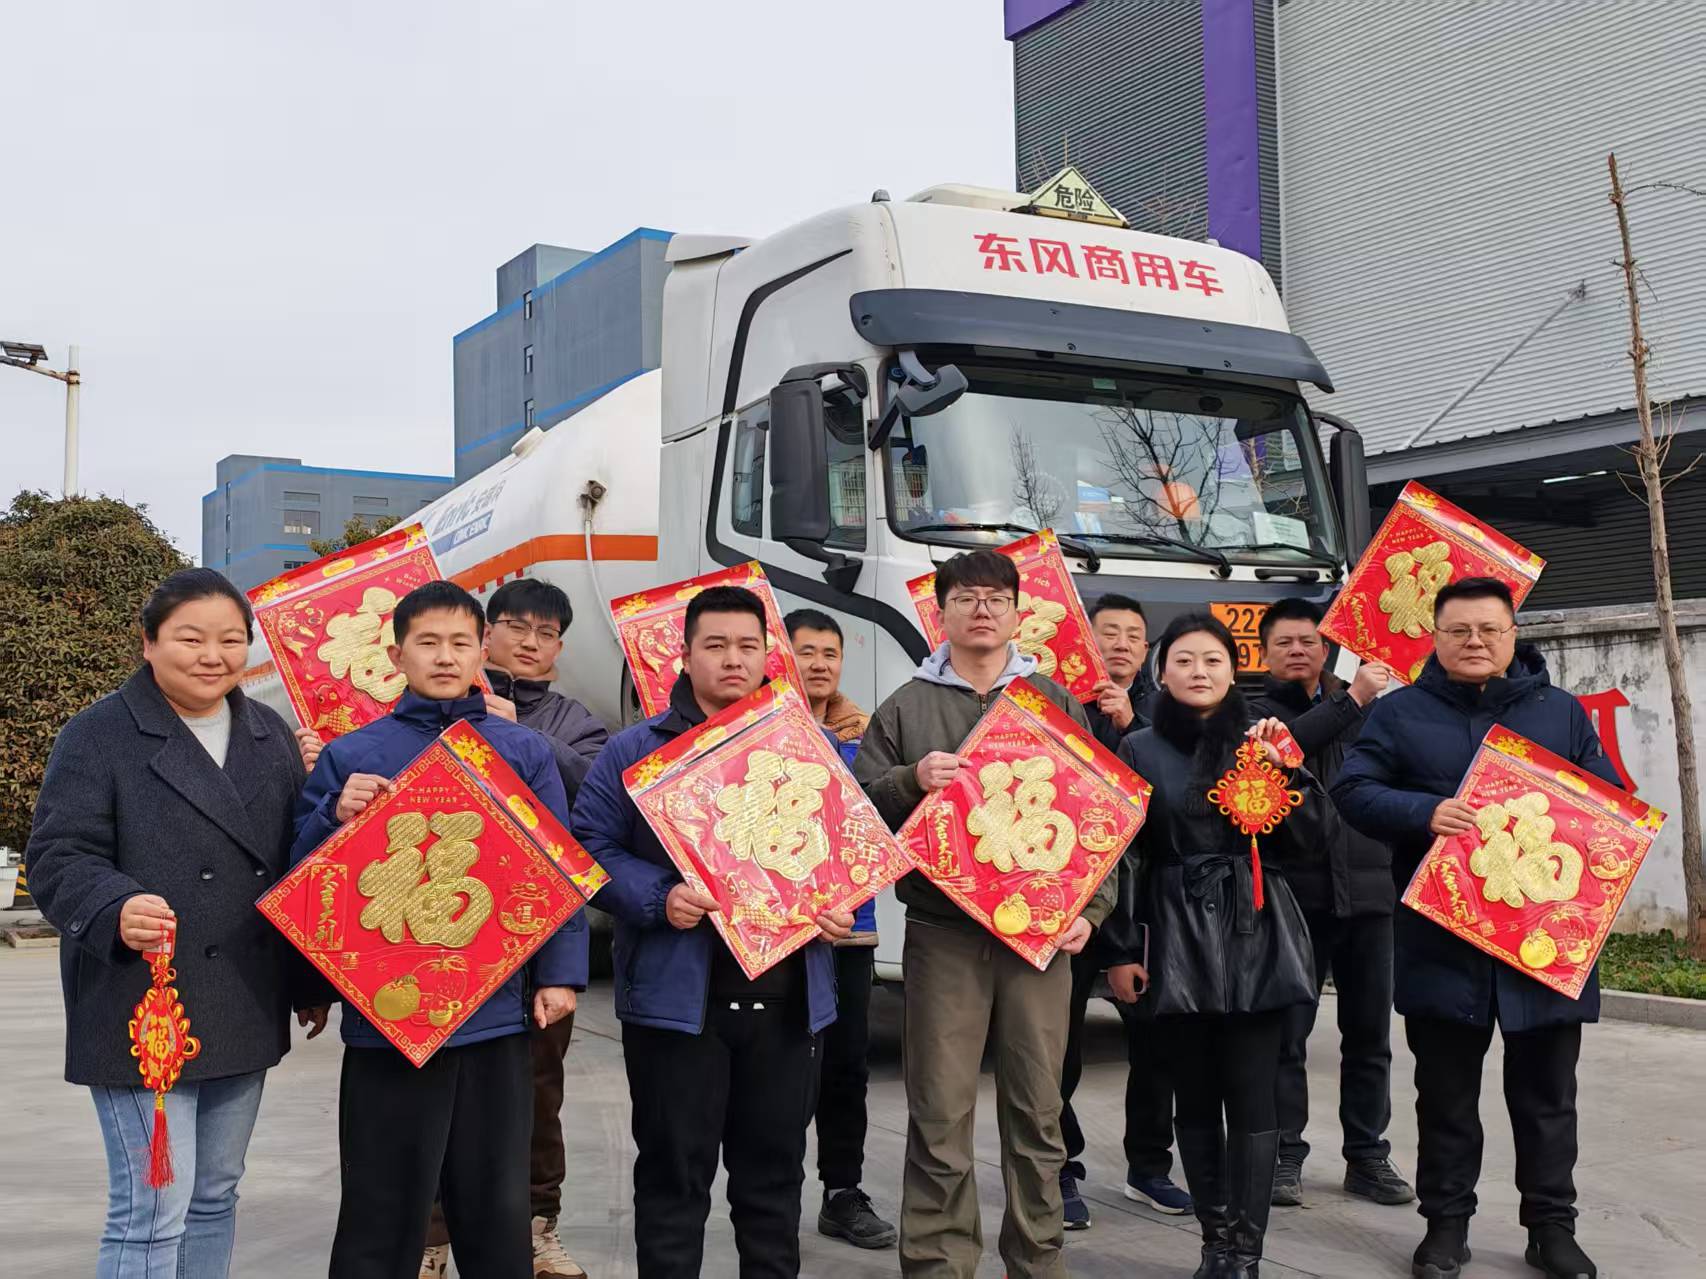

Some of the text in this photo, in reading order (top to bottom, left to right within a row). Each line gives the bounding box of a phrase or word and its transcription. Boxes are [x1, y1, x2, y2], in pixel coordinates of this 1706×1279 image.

[1054, 184, 1095, 211] 危险
[974, 233, 1224, 296] 东风商用车
[1033, 576, 1051, 588] rich
[1237, 643, 1265, 669] 97
[409, 796, 457, 804] NEW YEAR
[419, 786, 450, 794] HAPPY
[1234, 779, 1272, 815] 福
[714, 749, 831, 881] 福
[966, 755, 1077, 873] 福
[1470, 791, 1584, 909] 福
[358, 810, 495, 949] 福
[315, 868, 339, 950] 大吉大利
[146, 1014, 170, 1060] 福
